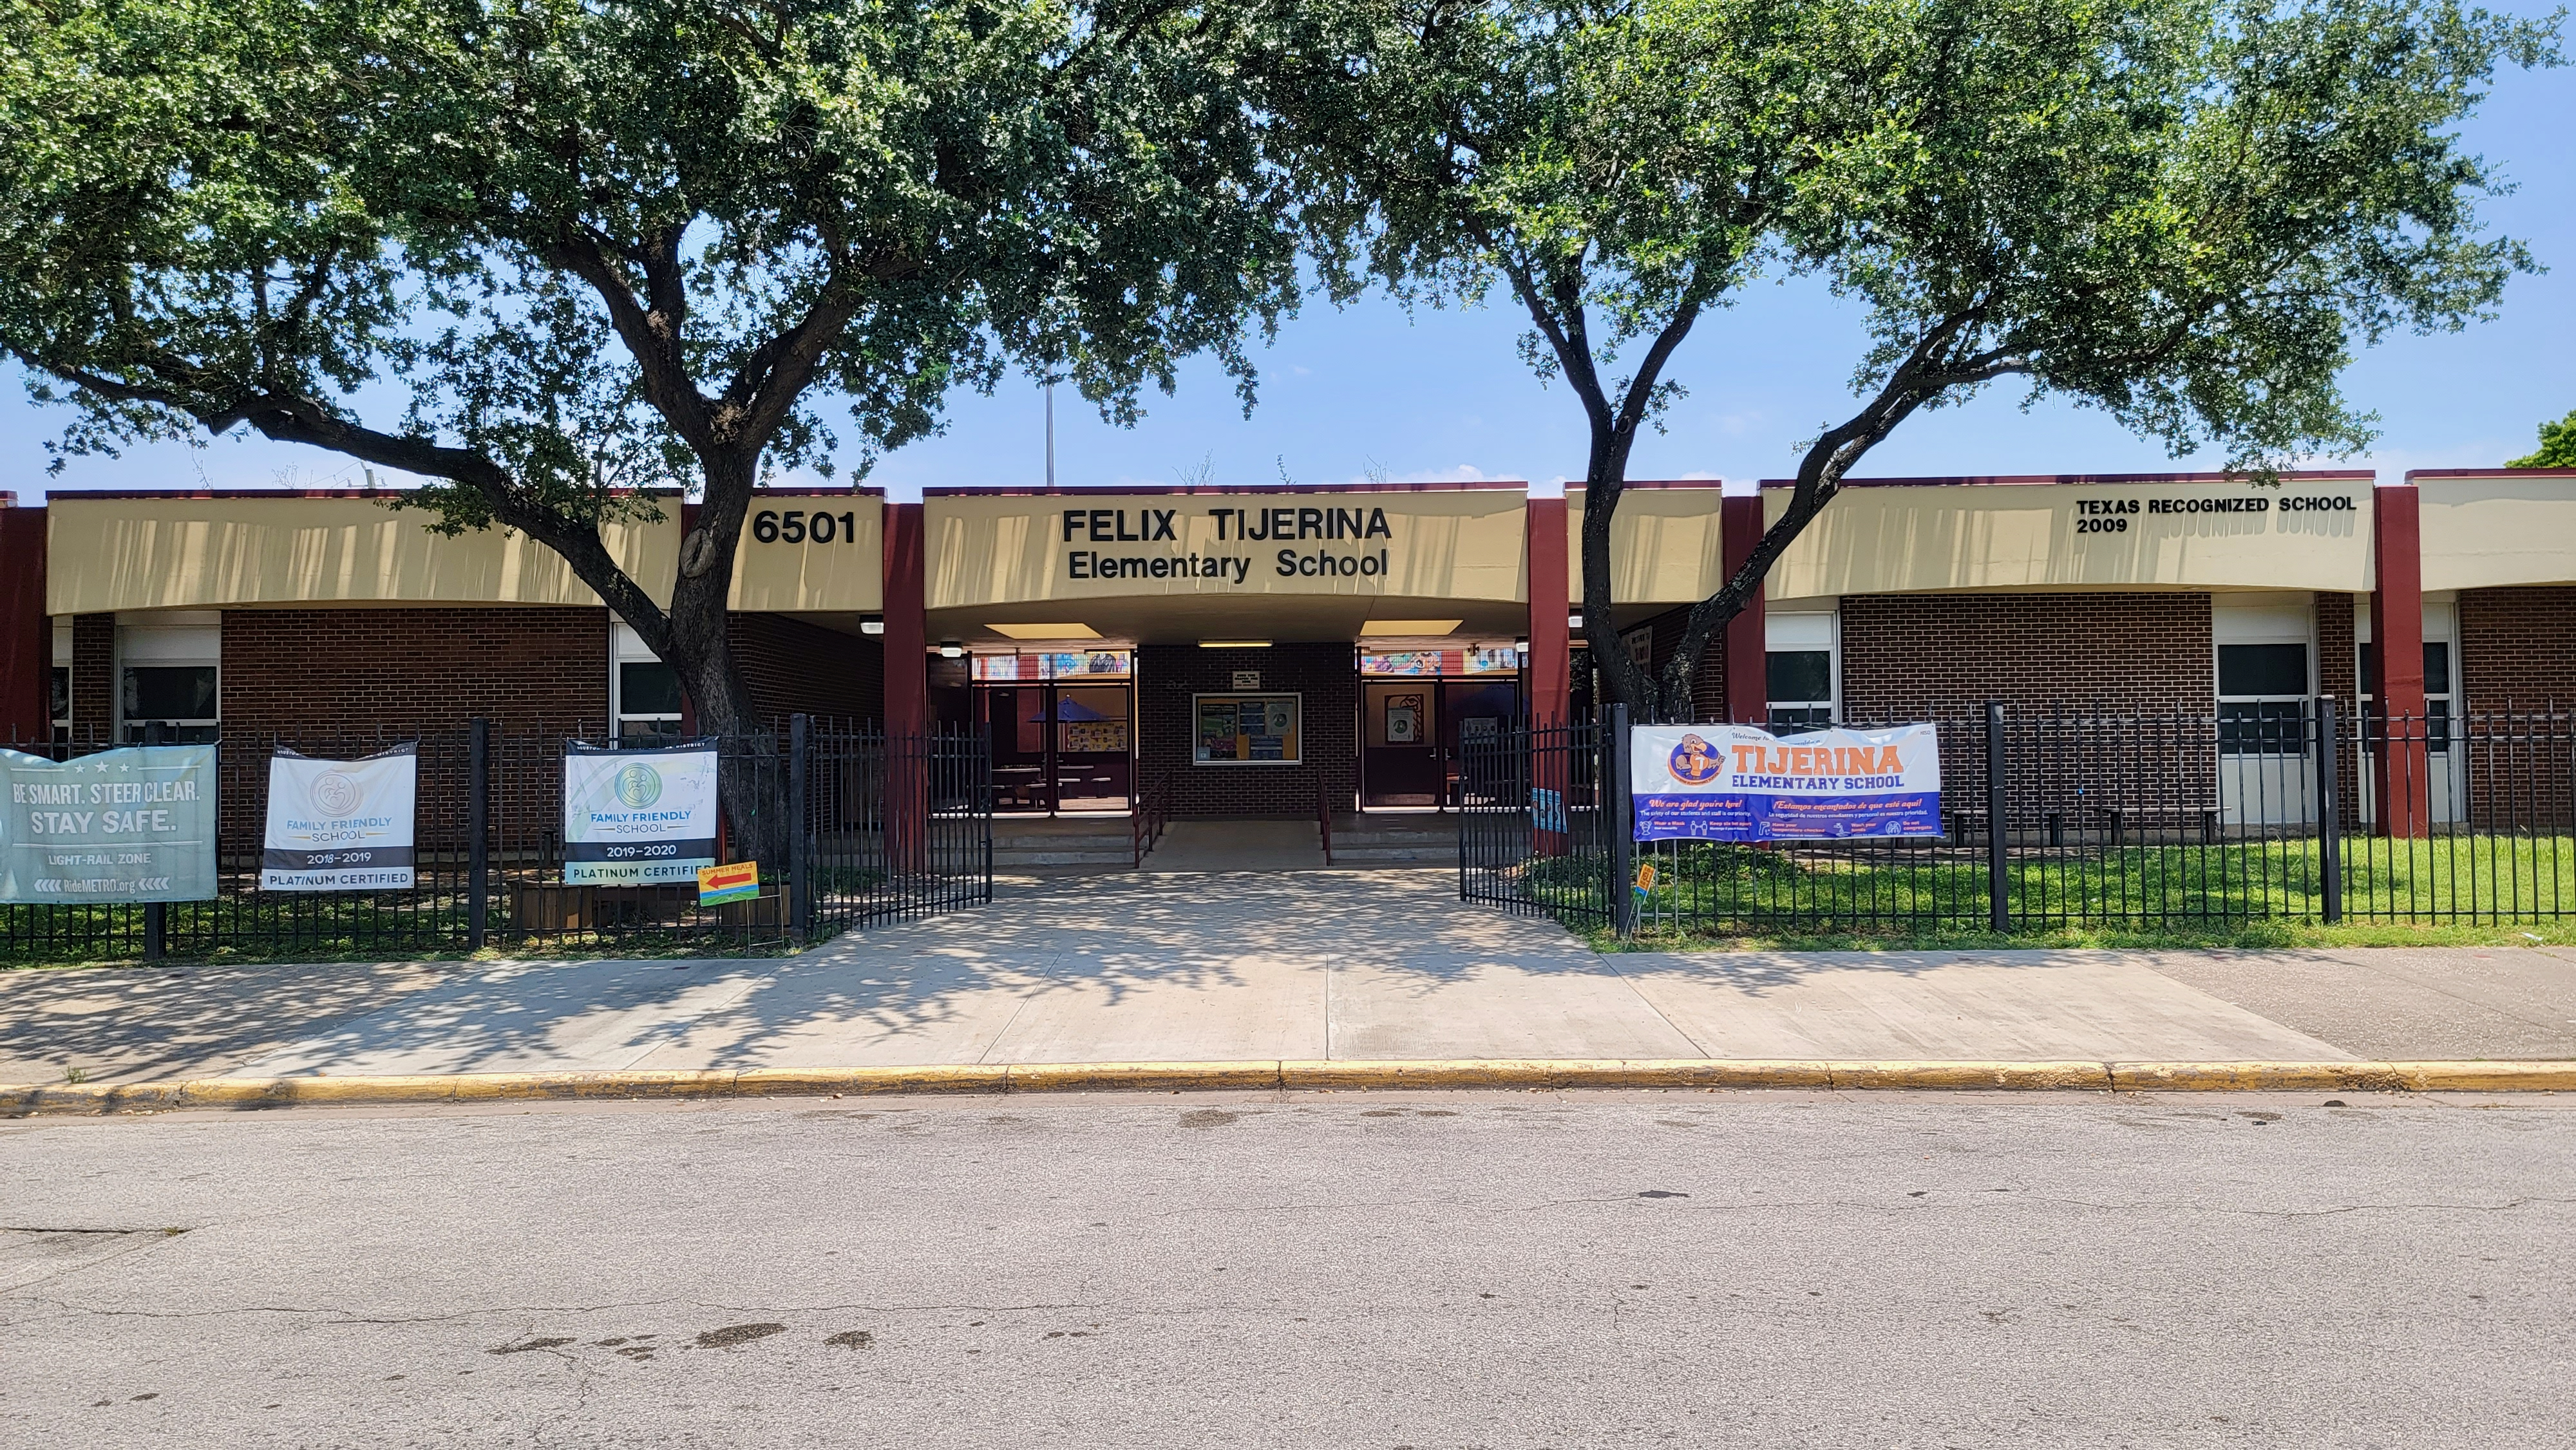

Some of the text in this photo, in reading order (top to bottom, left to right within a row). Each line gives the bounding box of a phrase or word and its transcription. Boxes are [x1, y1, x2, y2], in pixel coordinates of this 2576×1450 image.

[2076, 496, 2357, 514] TEXAS RECOGNIZED SCHOOL
[753, 510, 854, 543] 6501
[1063, 507, 1392, 542] FELIX TIJERINA
[2077, 518, 2128, 533] 2009
[1069, 549, 1387, 584] Elementary School
[1732, 732, 1761, 741] Welcome
[377, 748, 409, 757] DISTRICT
[1732, 744, 1904, 775] TIJERINA
[1732, 775, 1839, 790] ELEMENTARY
[1844, 775, 1904, 789] SCHOOL
[13, 780, 200, 805] BE SMART. STEER CLEAR.
[1680, 800, 1699, 811] glad
[1813, 802, 1857, 811] encantados
[32, 809, 176, 834] STAY SAFE.
[591, 811, 692, 823] FAMILY FRIENDLY
[287, 817, 392, 831] FAMILY FRIENDLY
[616, 824, 666, 834] SCHOOL
[312, 831, 365, 842] SCHOOL
[607, 845, 676, 857] 2019-2020
[48, 853, 152, 865] LIGHT-RAIL ZONE
[307, 852, 372, 864] 2018-2019
[573, 867, 639, 878] PLATINUM
[702, 867, 730, 876] SUMMER
[270, 874, 408, 885] PLATINUM CERTIFIED
[64, 879, 136, 894] RideMETRO.org
